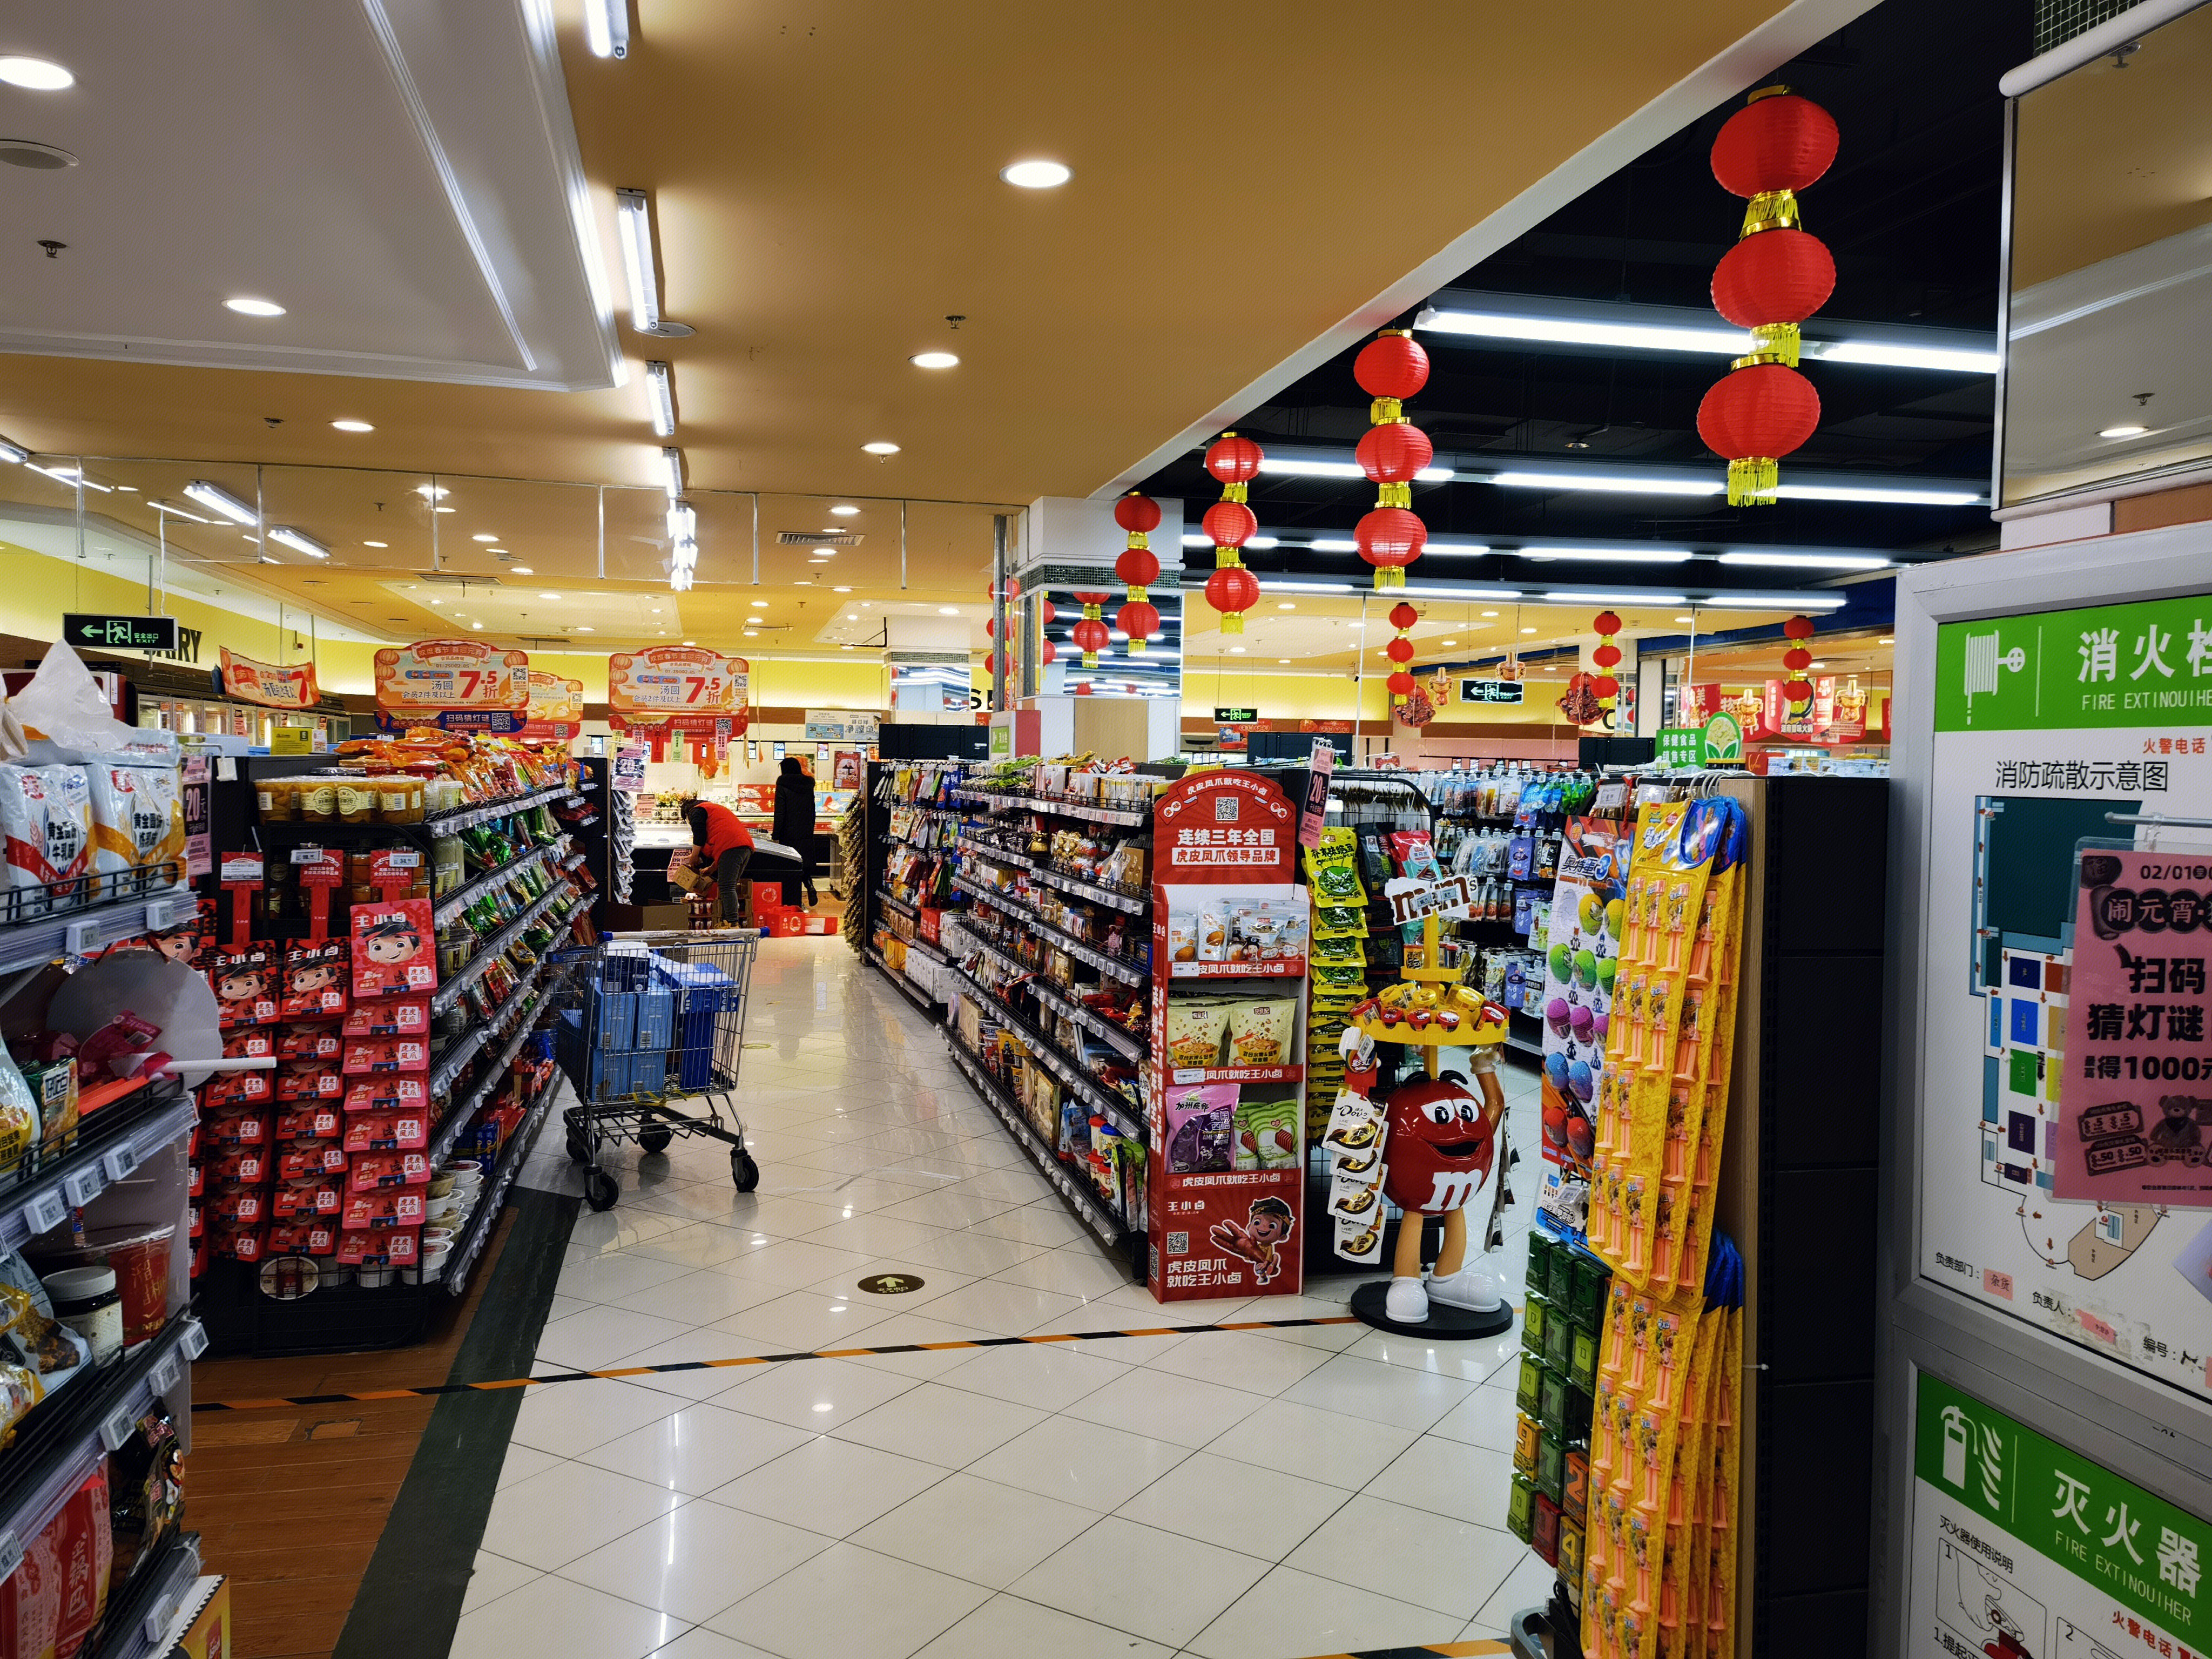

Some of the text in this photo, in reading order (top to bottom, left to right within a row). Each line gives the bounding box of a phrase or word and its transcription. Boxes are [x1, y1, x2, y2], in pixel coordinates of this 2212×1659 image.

[431, 680, 453, 691] 汤圆
[483, 684, 498, 699] 折
[660, 685, 680, 695] 汤圆
[633, 694, 682, 703] 会员2件及以上
[706, 691, 721, 704] 折
[2082, 694, 2116, 711] FIRE
[446, 714, 490, 723] 扫码猜灯谜
[674, 719, 713, 727] 扫码猜灯谜
[1663, 734, 1697, 747] 保健食品
[2143, 737, 2206, 754] 火警电话
[1662, 750, 1697, 764] 销售专区
[1995, 760, 2169, 792] 消防疏散示意图
[1187, 778, 1268, 797] 虎皮凤爪就吃王小卤
[1177, 828, 1275, 846] 连续三年全国
[1176, 849, 1276, 863] 虎皮凤爪领导品牌
[355, 912, 406, 927] 王小卤
[214, 952, 265, 966] 王小卤
[288, 946, 339, 961] 王小卤
[2129, 956, 2206, 995] 扫码
[2087, 1003, 2204, 1042] 猜灯谜
[1204, 1069, 1283, 1080] 凤爪就吃王小卤
[1182, 1173, 1280, 1187] 虎皮凤爪就吃王小卤
[1420, 1169, 1483, 1211] m
[1167, 1199, 1205, 1212] 王小卤
[1167, 1258, 1228, 1274] 虎皮凤爪
[1166, 1272, 1242, 1288] 就吃王小卤
[2051, 1468, 2202, 1599] 灭火器
[1939, 1514, 2014, 1575] 灭火器使用说明
[1944, 1545, 1952, 1560] 1
[2054, 1529, 2191, 1627] FIRE EXTINOUIHER
[2065, 1624, 2075, 1642] 2
[2111, 1610, 2173, 1658] 火警电话
